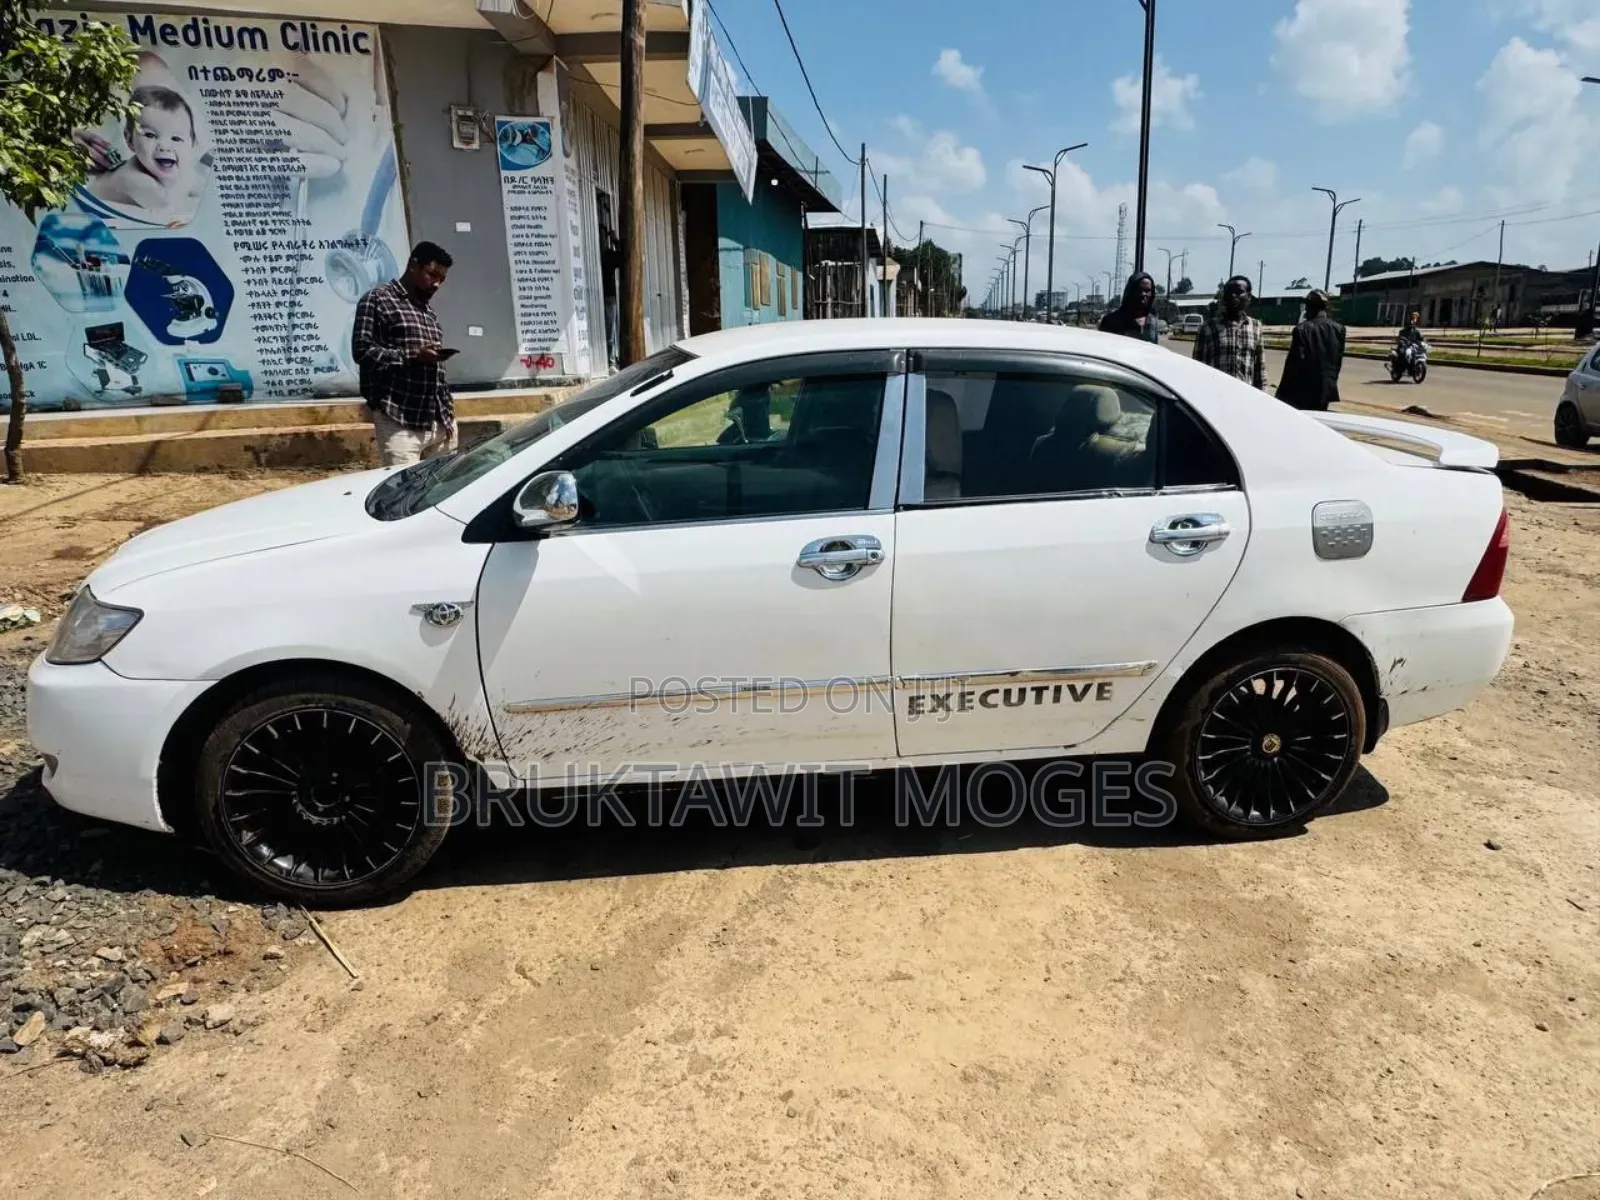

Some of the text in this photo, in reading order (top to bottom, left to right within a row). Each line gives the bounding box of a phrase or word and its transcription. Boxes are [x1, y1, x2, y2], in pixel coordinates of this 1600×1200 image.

[127, 14, 269, 50] Medium
[280, 21, 372, 54] Clinic
[908, 681, 1113, 716] EXECUTIVE
